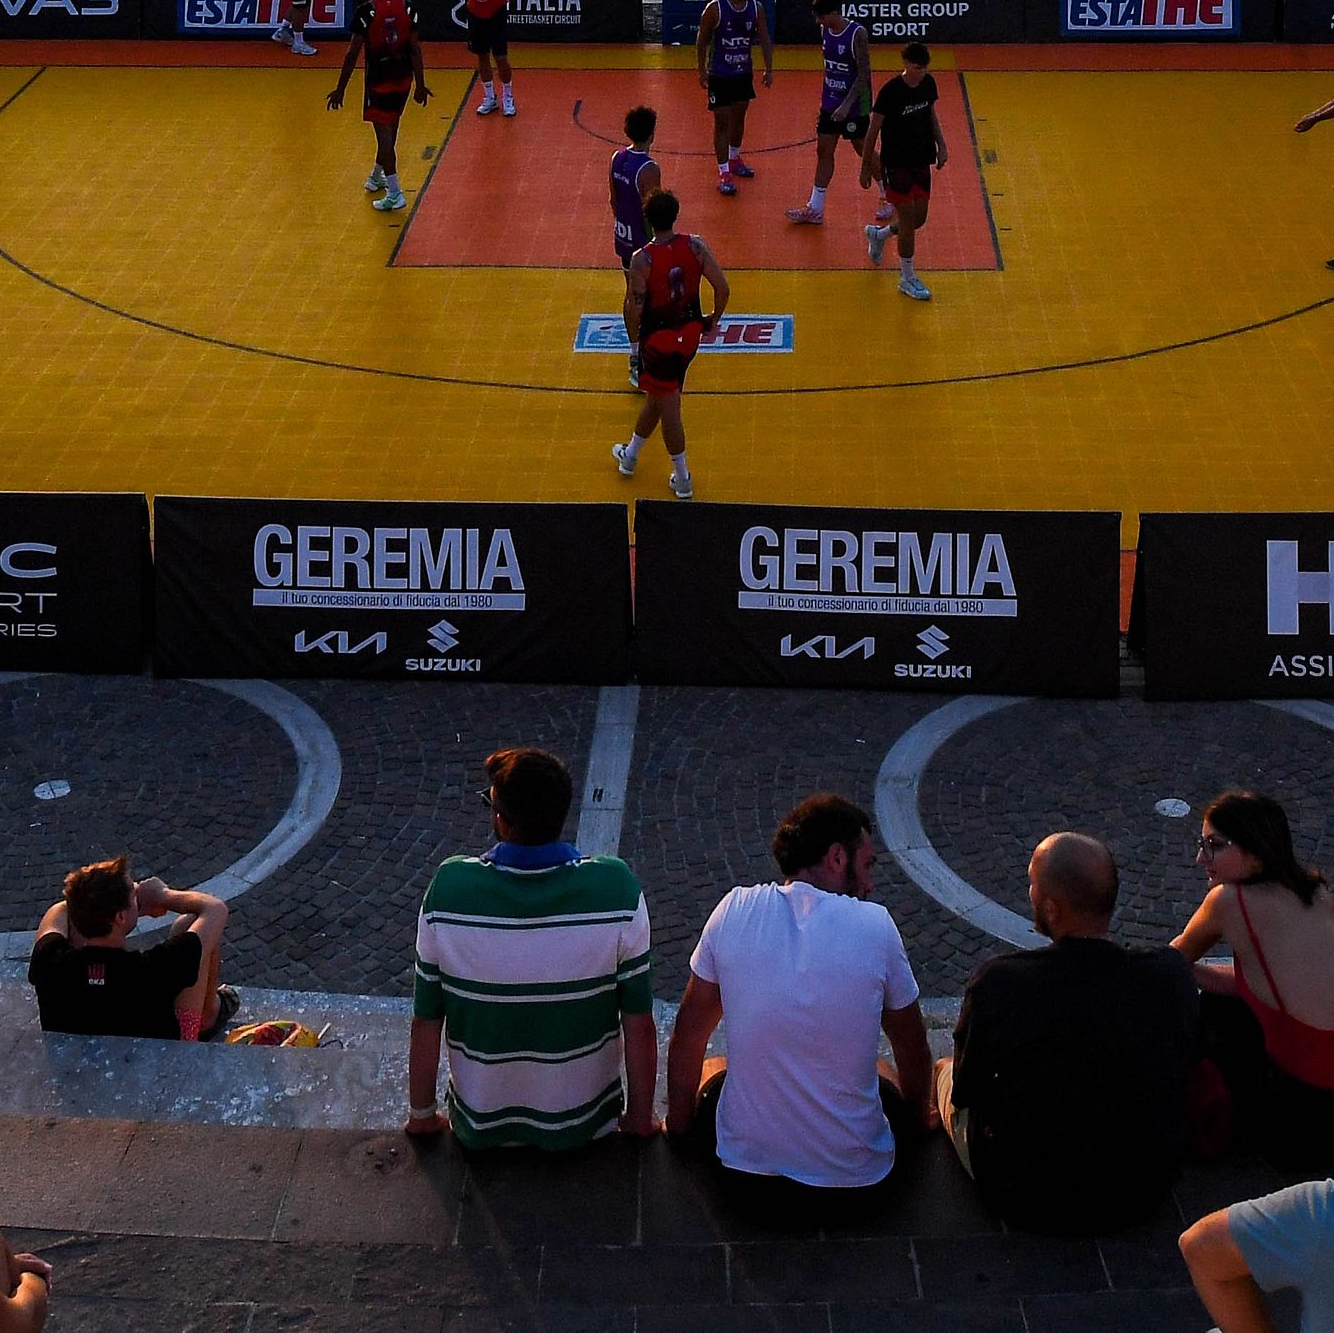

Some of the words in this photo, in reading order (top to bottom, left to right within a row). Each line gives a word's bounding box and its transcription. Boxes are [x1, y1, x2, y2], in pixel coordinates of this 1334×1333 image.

[907, 2, 970, 17] GROUP
[872, 22, 930, 36] SPORT
[253, 523, 525, 591] GEREMIA
[738, 525, 1018, 597] GEREMIA
[282, 591, 289, 604] il
[291, 593, 308, 605] tuo
[311, 593, 390, 607] concessionario
[393, 594, 404, 607] di
[406, 594, 442, 608] fiducia
[444, 595, 461, 608] dal
[464, 595, 493, 609] 1980
[768, 595, 774, 607] il
[777, 596, 795, 608] tuo
[797, 597, 878, 611] concessionario
[881, 598, 892, 611] di
[894, 599, 931, 612] fiducia
[934, 600, 951, 613] dal
[954, 600, 984, 614] 1980
[405, 657, 482, 672] SUZUKI
[893, 663, 972, 679] SUZUKI
